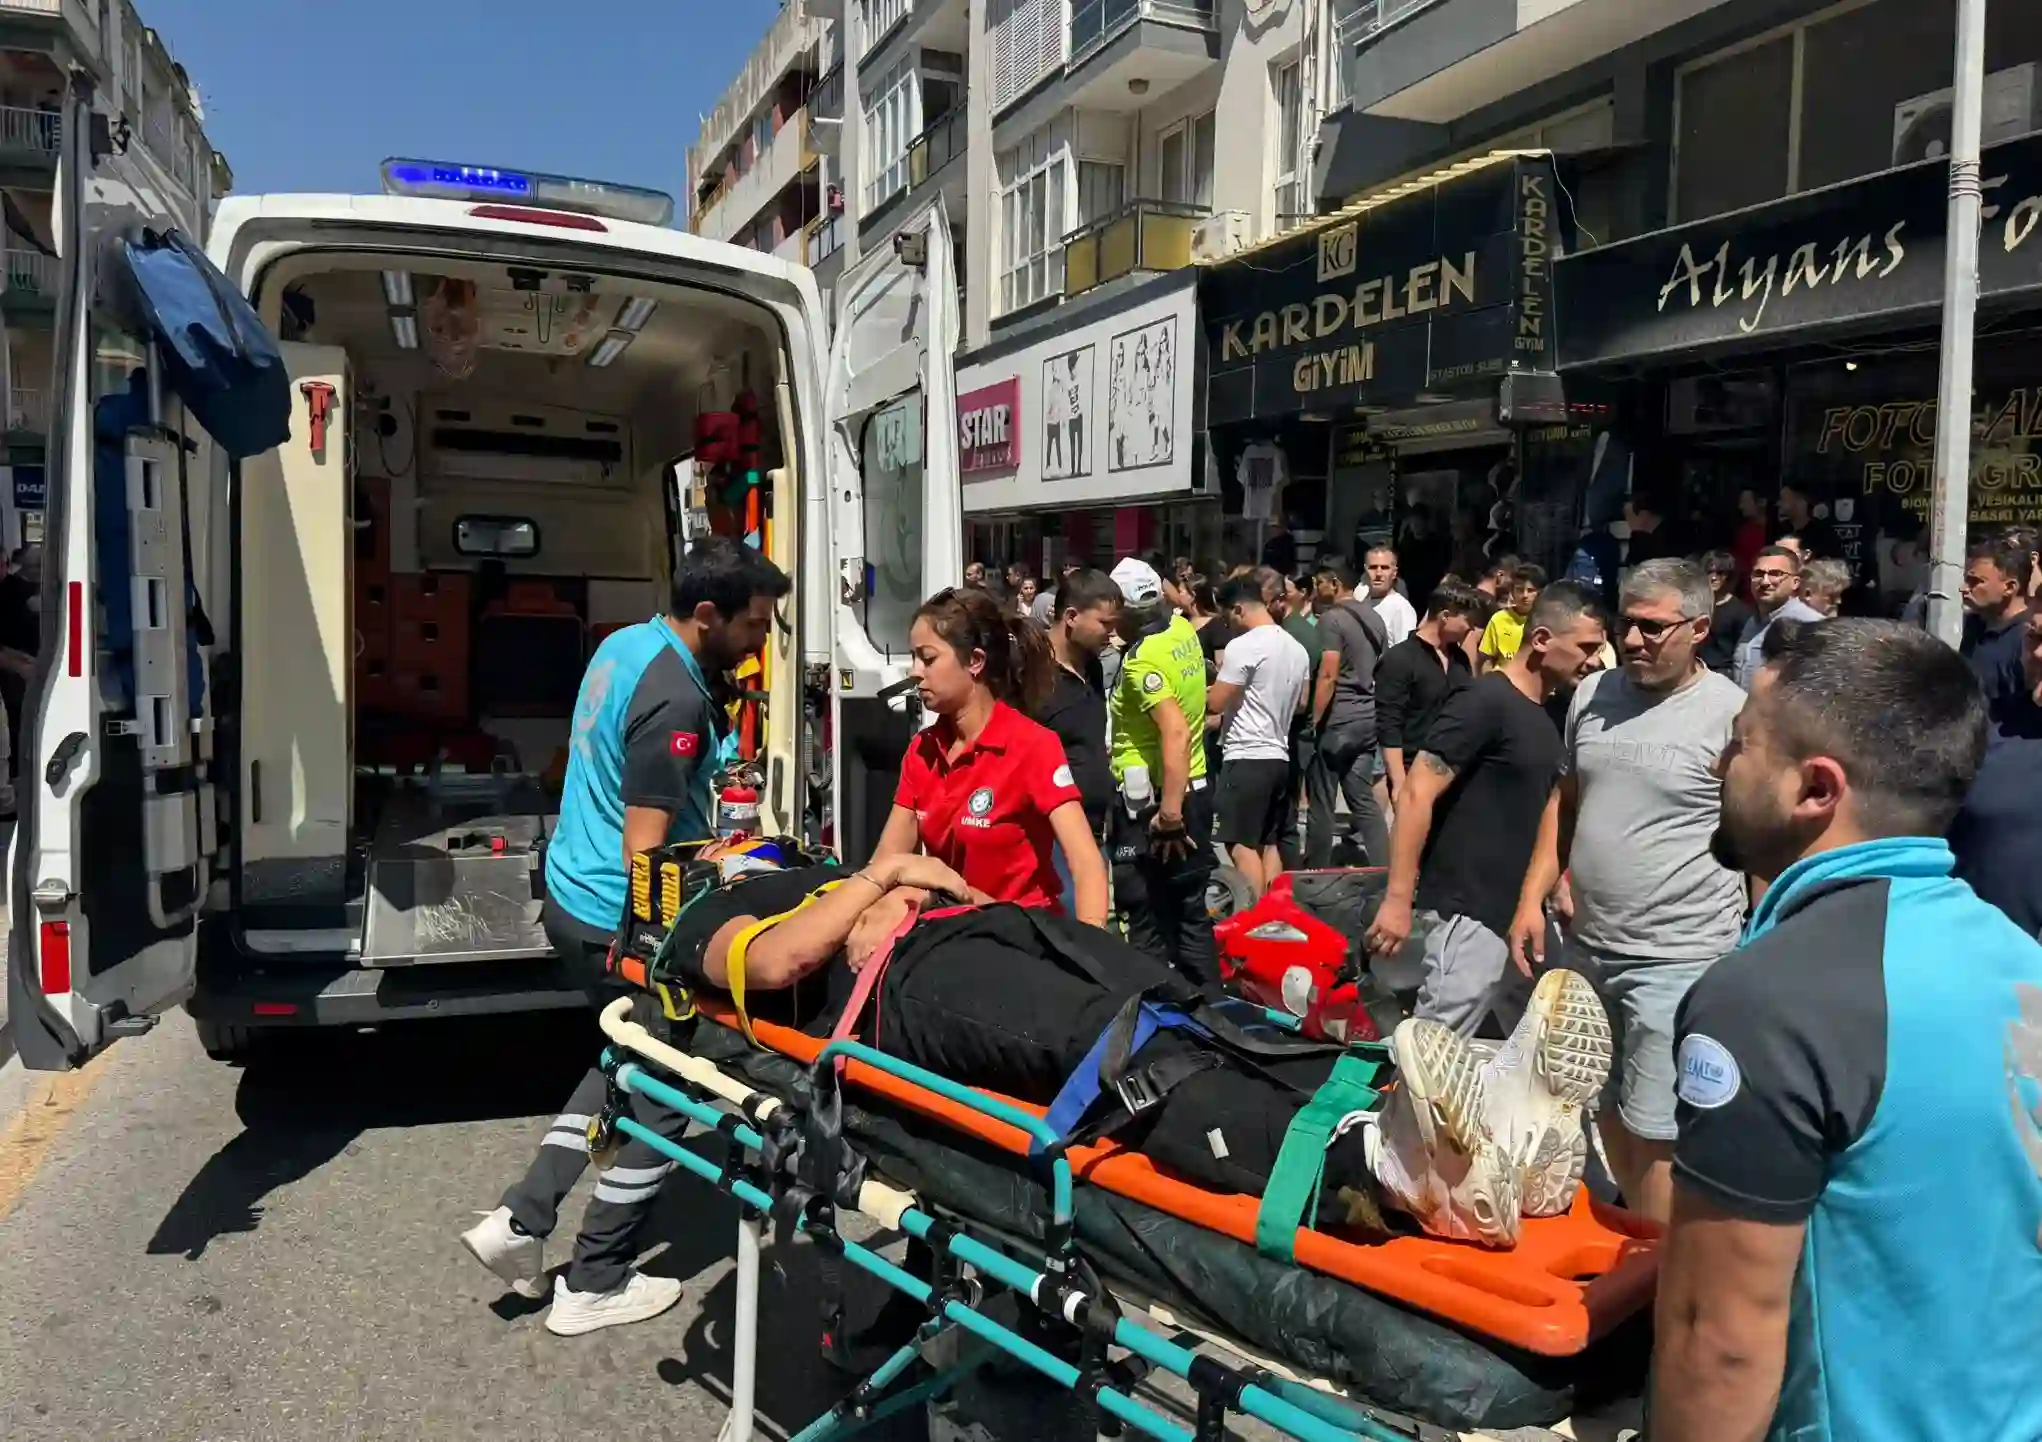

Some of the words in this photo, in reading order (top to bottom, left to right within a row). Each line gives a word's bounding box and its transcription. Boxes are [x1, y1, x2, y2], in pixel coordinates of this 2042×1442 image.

[1222, 251, 1476, 362] KARDELEN
[1520, 174, 1547, 335] KARDELEN
[1657, 219, 1906, 332] Alyans
[1293, 341, 1375, 392] GİYİM
[961, 404, 1009, 450] STAR
